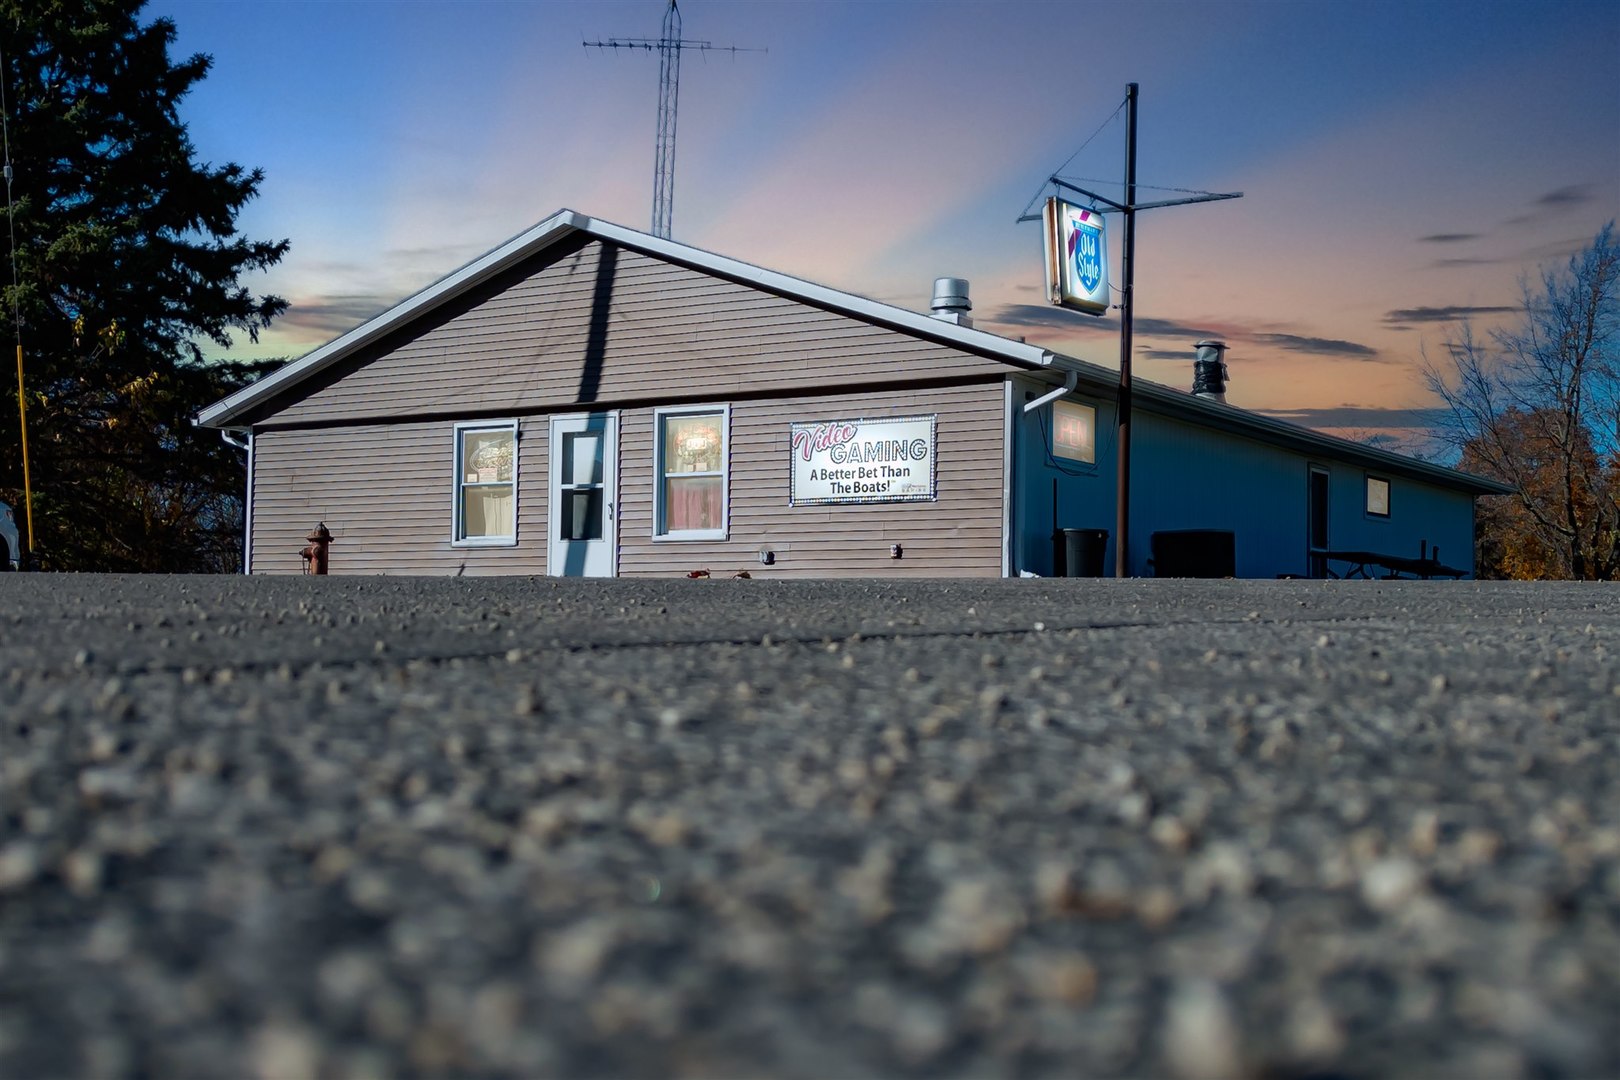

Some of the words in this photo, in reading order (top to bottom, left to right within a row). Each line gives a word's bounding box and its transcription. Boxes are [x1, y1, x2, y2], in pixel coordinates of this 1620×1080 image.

[1080, 233, 1096, 257] Old
[1078, 252, 1099, 286] Style
[793, 422, 857, 461] Video
[830, 438, 928, 464] GAMING
[810, 469, 818, 481] A
[820, 468, 857, 481] Better
[858, 466, 877, 479] Bet
[880, 465, 910, 478] Than
[830, 482, 851, 494] The
[853, 480, 891, 494] Boats!
